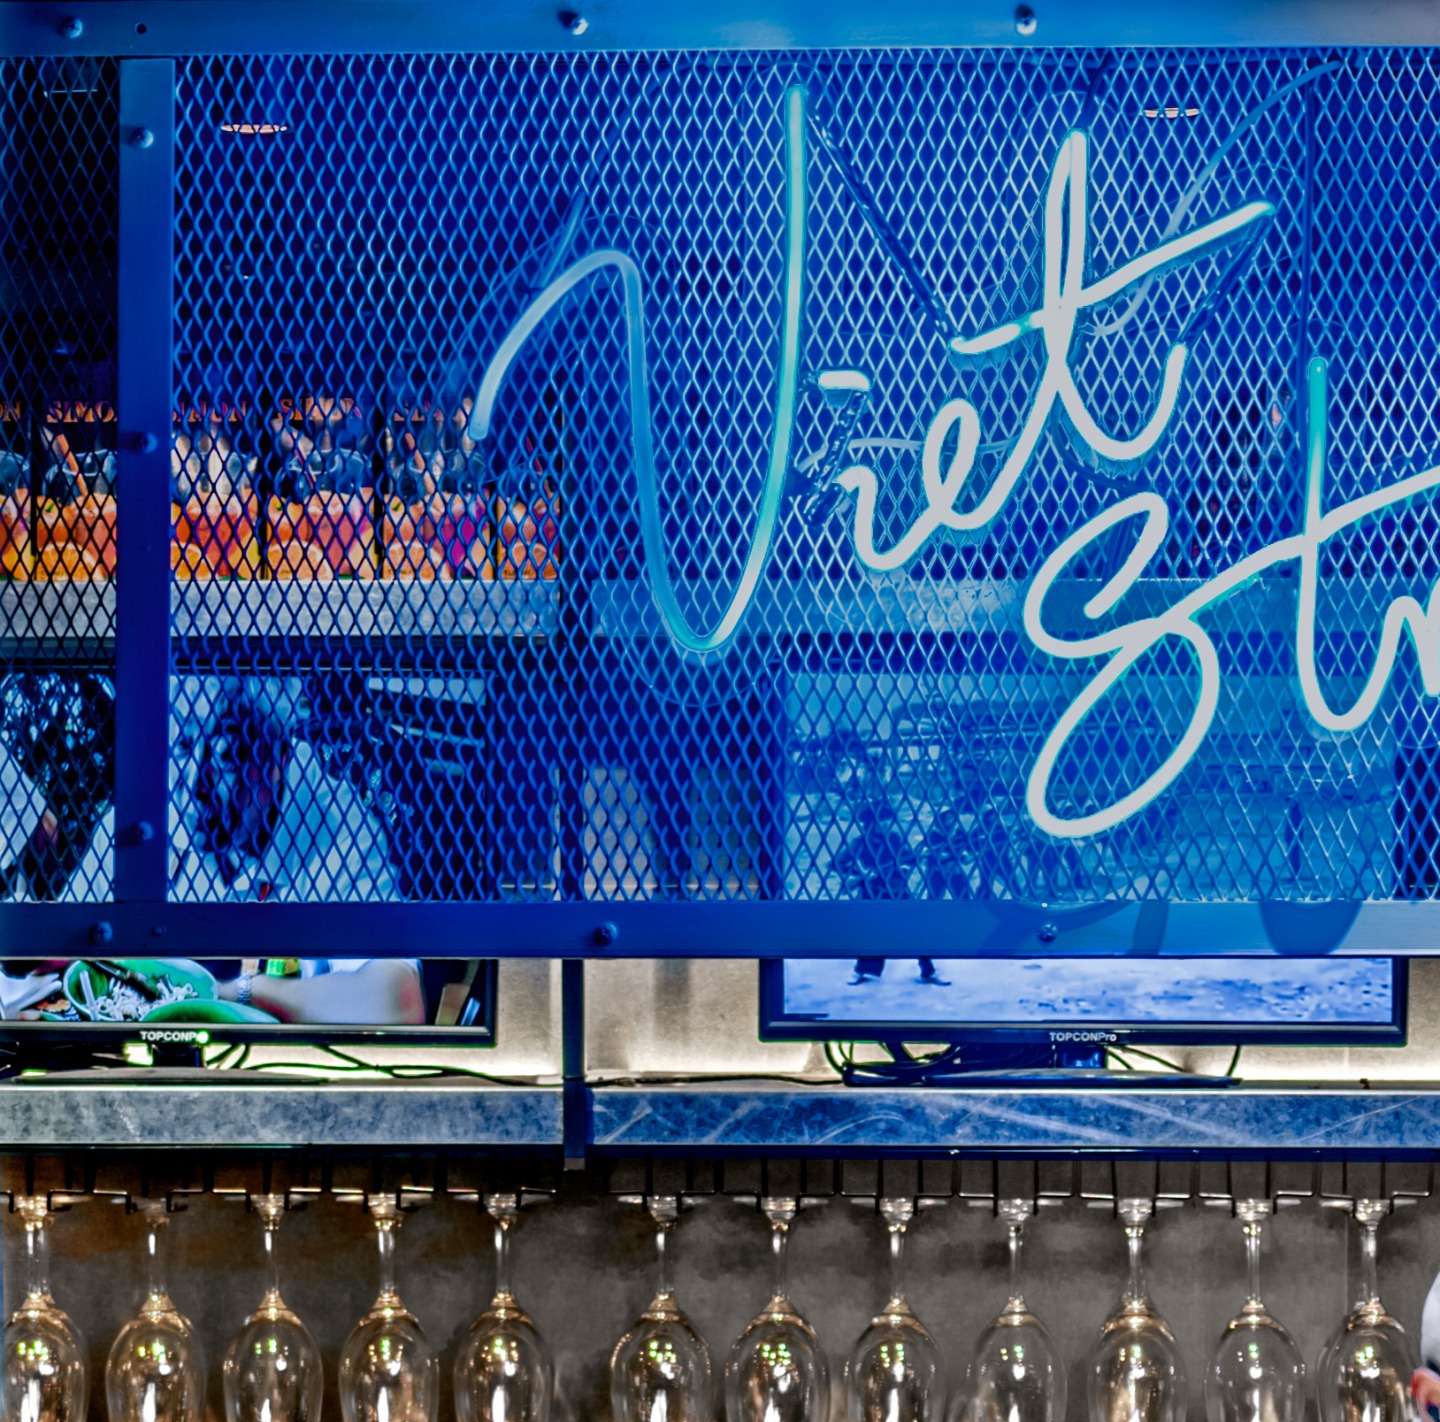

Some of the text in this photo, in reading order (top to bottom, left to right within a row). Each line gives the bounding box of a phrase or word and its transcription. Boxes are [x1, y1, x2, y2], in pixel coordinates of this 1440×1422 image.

[467, 86, 1275, 653] Viet
[46, 400, 118, 423] SIMO
[140, 1031, 209, 1042] TOPCONP
